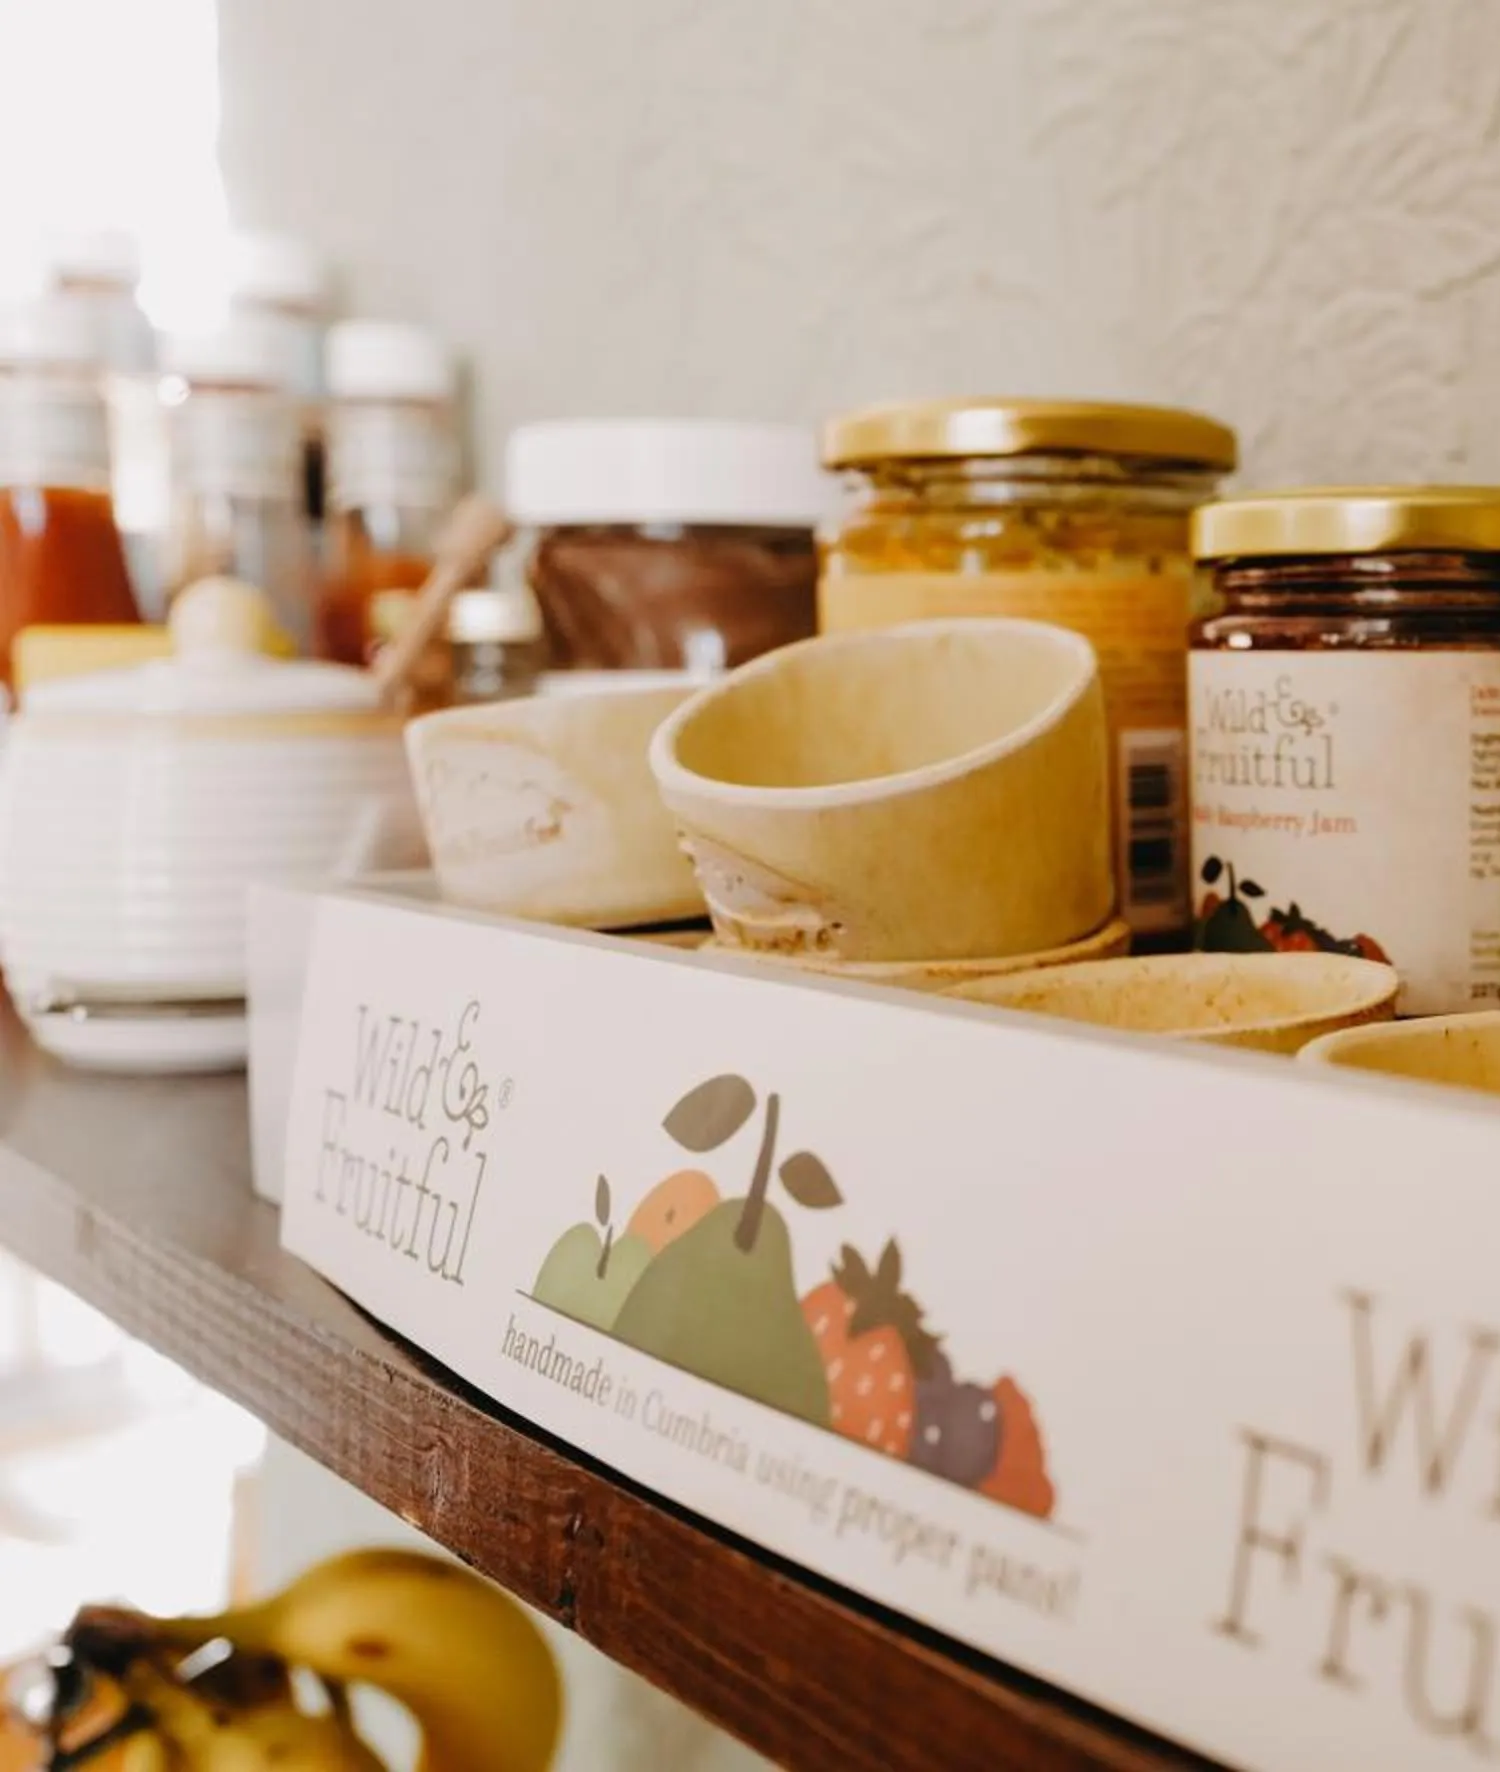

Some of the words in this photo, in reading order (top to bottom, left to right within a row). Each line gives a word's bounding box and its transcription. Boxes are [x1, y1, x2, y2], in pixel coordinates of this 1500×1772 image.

[352, 1003, 443, 1131] Wild
[438, 999, 490, 1152] &
[313, 1087, 487, 1288] Fruitful
[500, 1313, 613, 1408] handmade
[612, 1374, 638, 1420] in
[641, 1388, 751, 1475] Cumbria
[836, 1483, 961, 1570] proper
